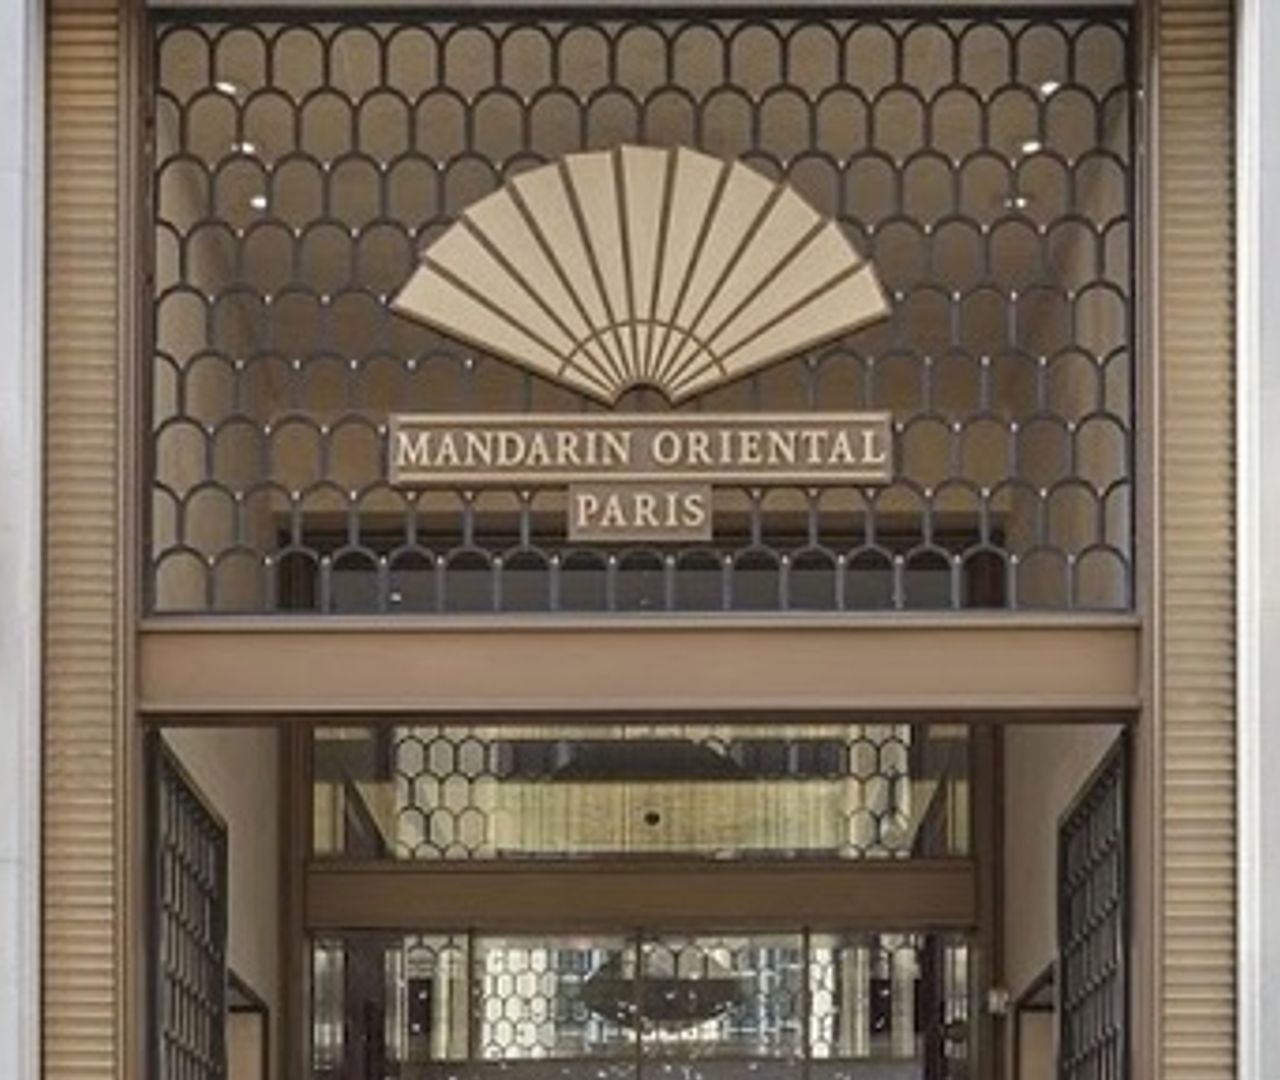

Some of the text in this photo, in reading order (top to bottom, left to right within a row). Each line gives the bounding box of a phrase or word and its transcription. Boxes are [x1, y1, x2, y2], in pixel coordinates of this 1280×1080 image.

[396, 429, 886, 466] MANDARIN ORIENTAL
[575, 494, 706, 527] PARIS
